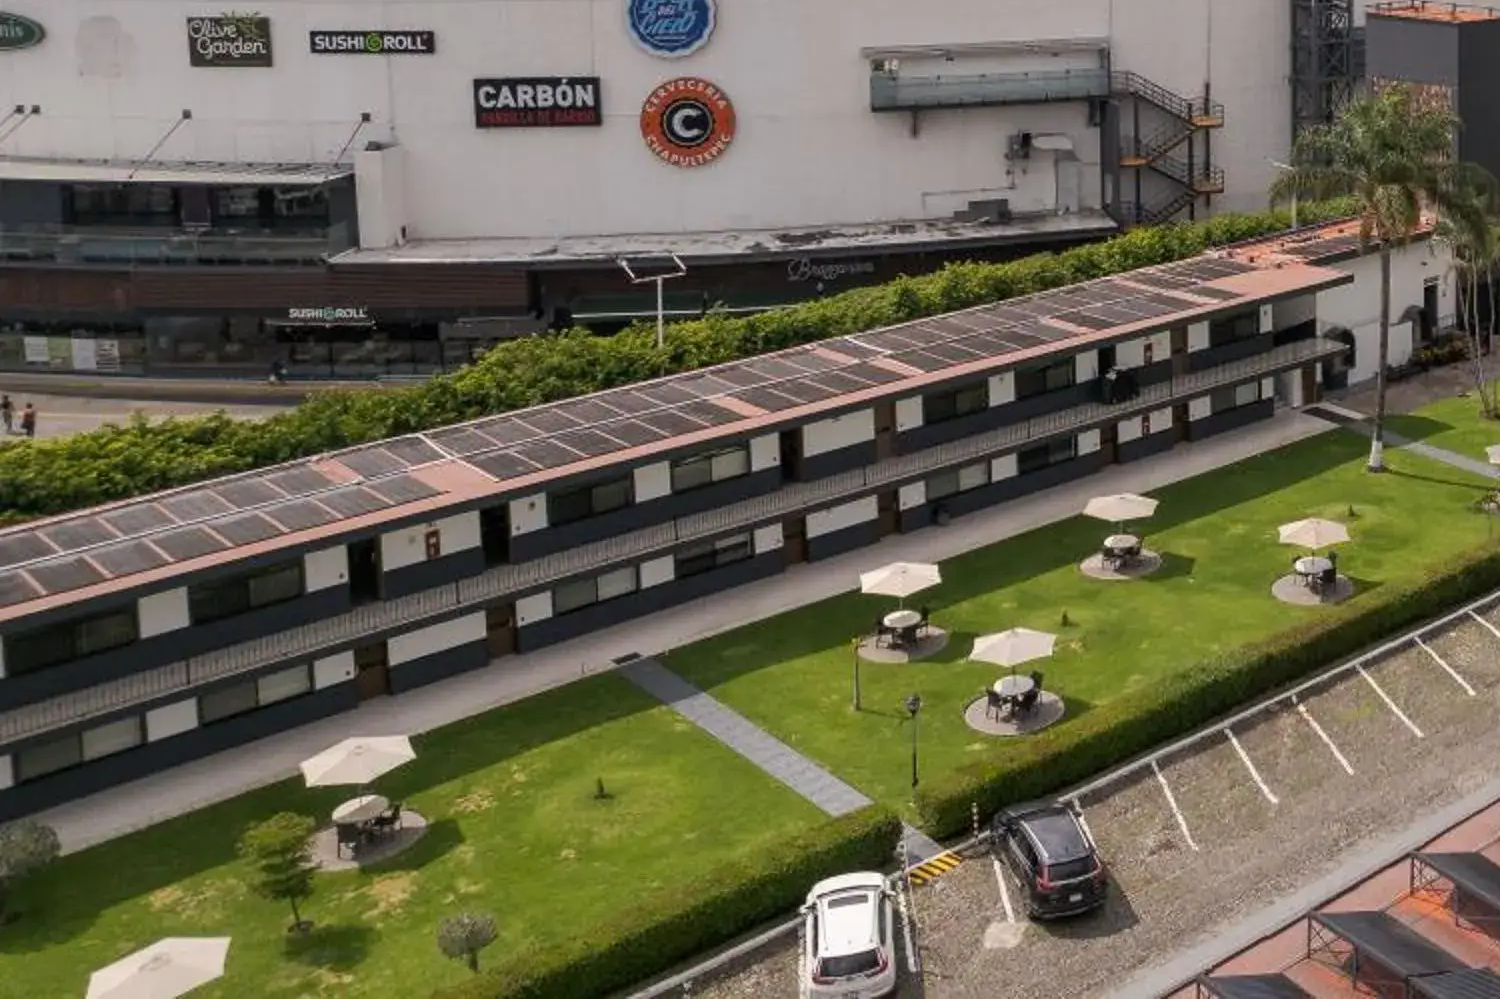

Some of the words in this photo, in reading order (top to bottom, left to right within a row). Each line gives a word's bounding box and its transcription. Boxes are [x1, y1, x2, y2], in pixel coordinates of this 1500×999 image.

[190, 20, 239, 38] Olive
[197, 37, 267, 59] Garden
[314, 34, 365, 50] SUSHI
[383, 34, 428, 50] ROLL
[478, 78, 595, 108] CARBÓN
[673, 108, 704, 138] C
[647, 134, 732, 166] CHAPULTEPEC
[288, 307, 322, 319] SUSHI
[335, 307, 368, 319] ROLL
